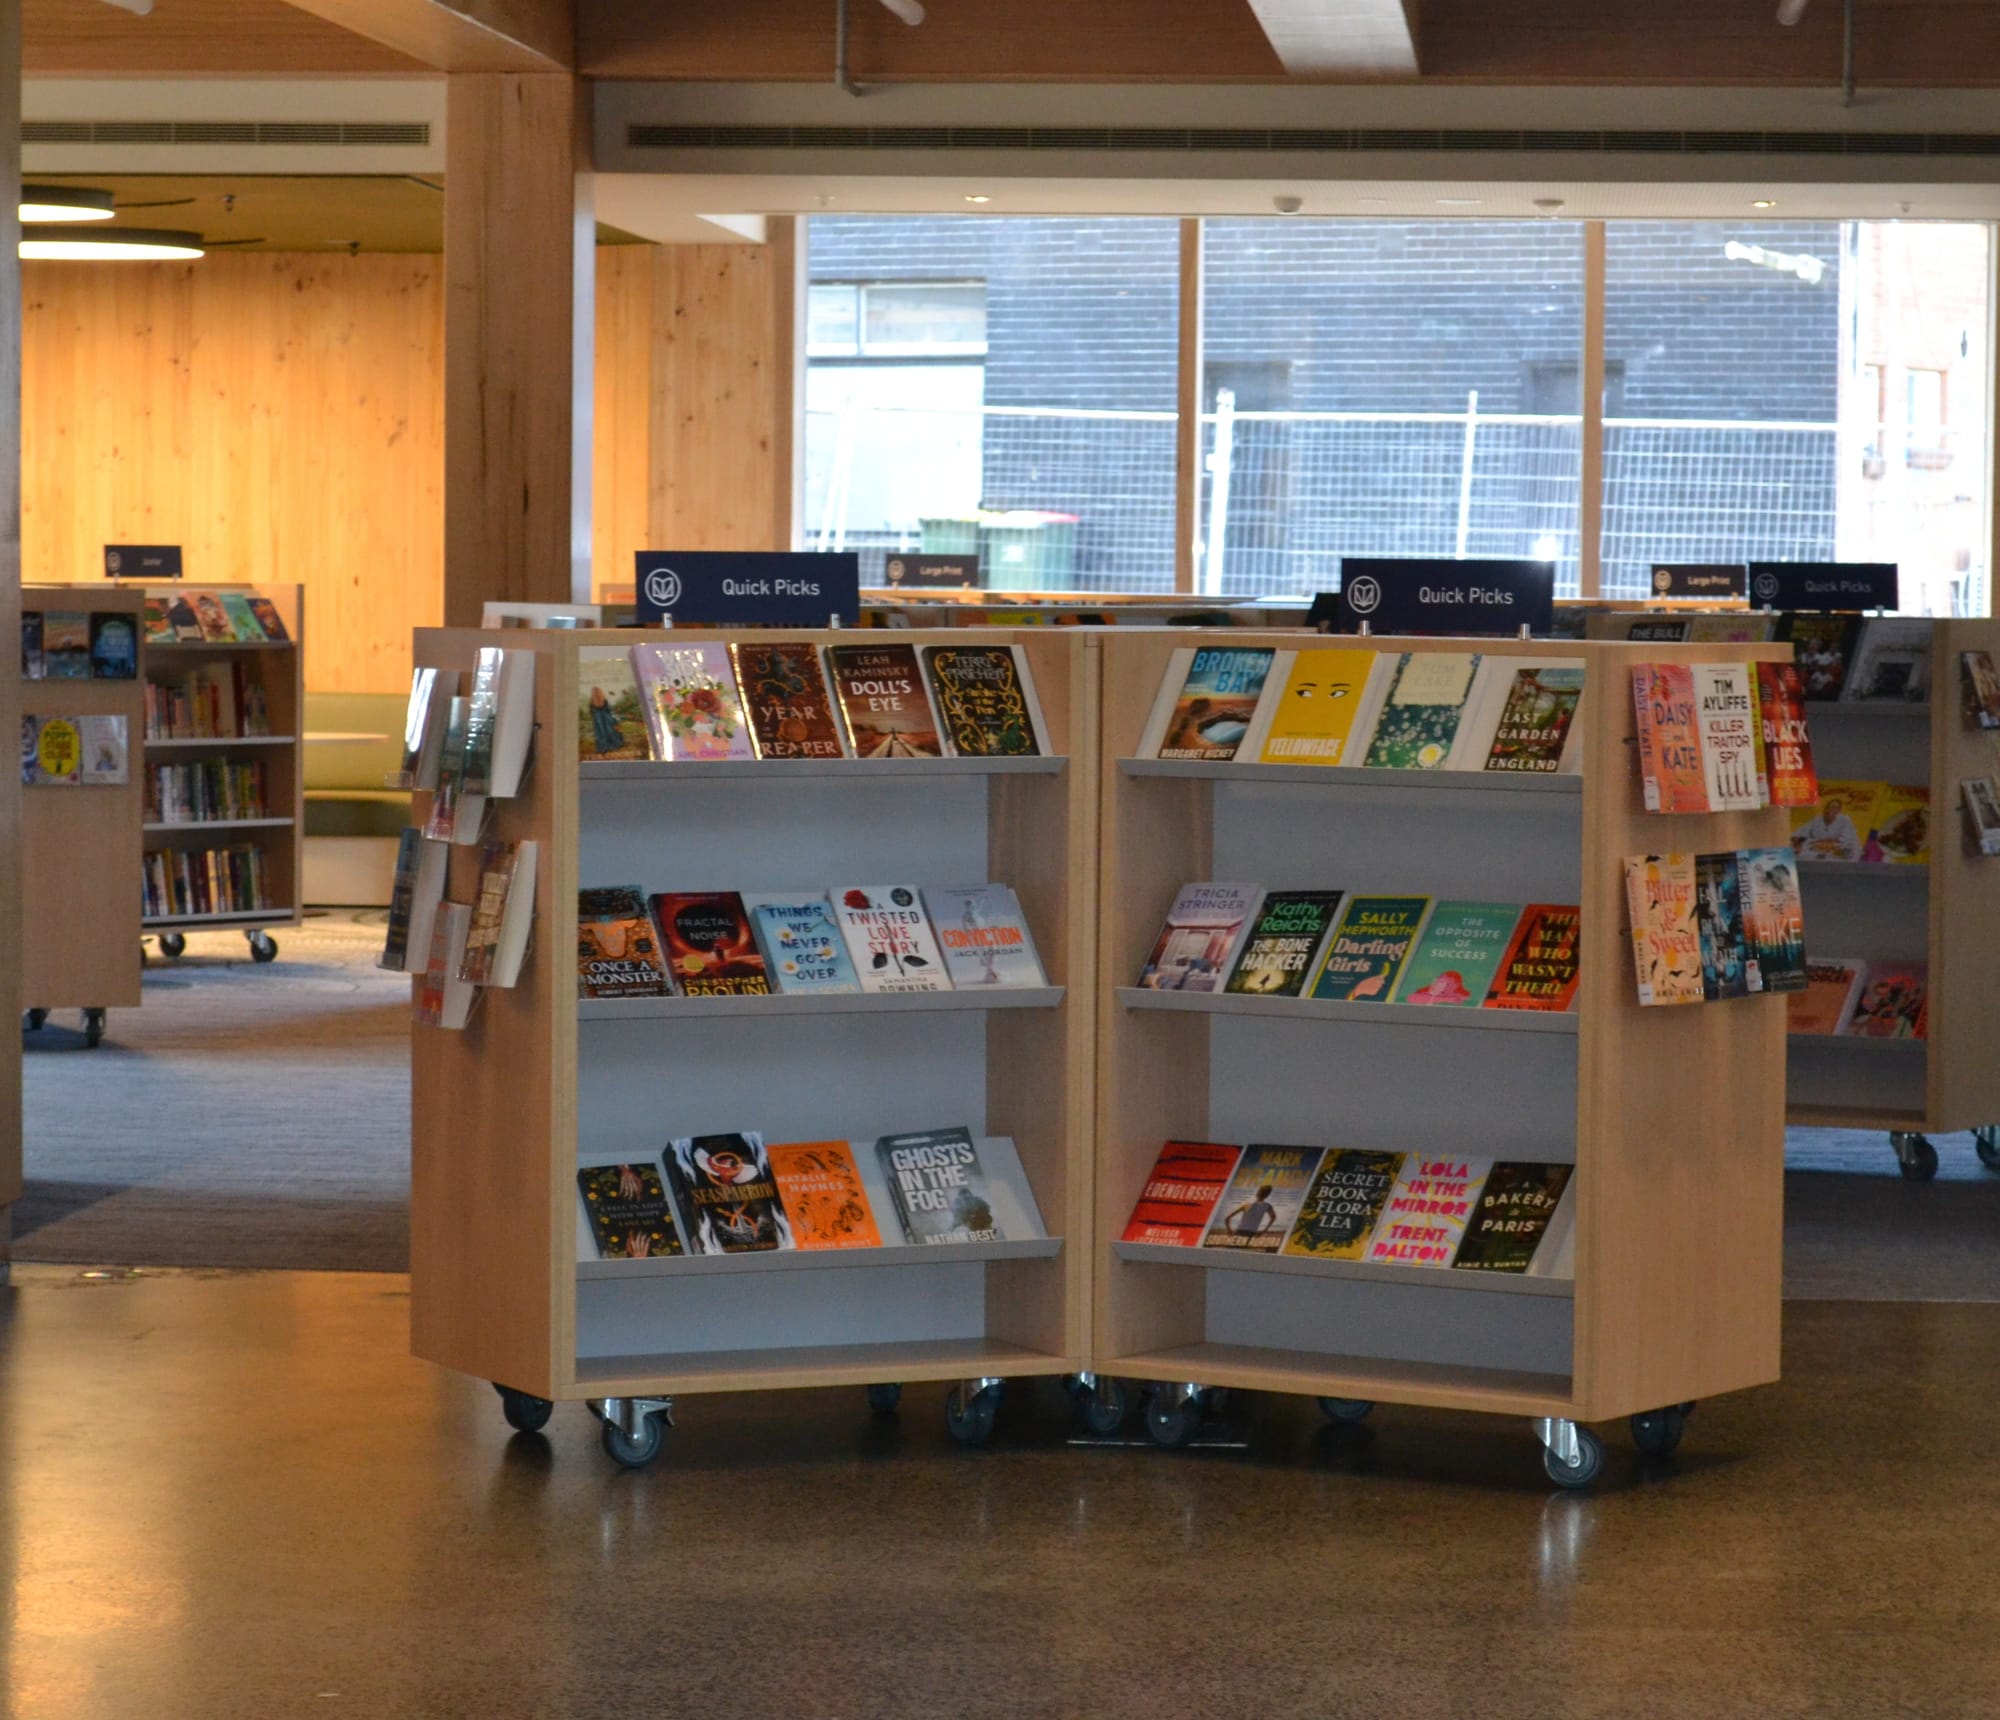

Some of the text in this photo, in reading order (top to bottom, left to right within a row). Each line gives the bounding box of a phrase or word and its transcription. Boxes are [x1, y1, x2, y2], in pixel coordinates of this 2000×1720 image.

[722, 578, 821, 596] Quick Picks
[1805, 580, 1872, 593] Quick Picks
[1418, 586, 1514, 604] Quick Picks
[857, 655, 891, 665] LEAH
[1193, 651, 1273, 673] BROKEN
[850, 680, 912, 696] DOLL'S
[1215, 671, 1260, 693] BAY
[1713, 680, 1734, 694] TIM
[868, 697, 903, 712] EYE
[1703, 696, 1749, 711] AYLIFFE
[760, 706, 817, 722] YEAR
[1502, 713, 1540, 723] LAST
[1653, 702, 1693, 726] DAISY
[1710, 719, 1745, 733] KILLER
[1762, 719, 1809, 743] BLACK
[1497, 729, 1560, 739] GARDEN
[1707, 734, 1751, 748] TRAITOR
[759, 741, 837, 756] REAPER
[1662, 746, 1697, 770] KATE
[1719, 751, 1739, 764] SPY
[1773, 747, 1804, 770] LIES
[1488, 760, 1557, 771] ENGLAND
[1193, 888, 1239, 899] TRICIA
[1178, 899, 1245, 910] STRINGER
[1272, 901, 1324, 917] Kathy
[767, 907, 823, 919] THINGS
[847, 912, 920, 925] TWISTED
[1359, 912, 1409, 924] SALLY
[676, 918, 734, 927] FRACTAL
[788, 922, 812, 933] WE
[1259, 917, 1321, 932] Reichs
[1461, 918, 1485, 927] THE
[689, 931, 729, 941] NOISE
[868, 927, 911, 940] LOVE
[942, 927, 1023, 948] CONVICTION
[1338, 925, 1416, 936] HEPWORTH
[1435, 928, 1503, 939] OPPOSITE
[1538, 930, 1578, 942] MAN
[1758, 917, 1803, 946] HIKE
[780, 938, 830, 950] NEVER
[868, 942, 920, 954] STORY
[1276, 938, 1313, 952] BONE
[1333, 938, 1408, 961] Darling
[1455, 938, 1471, 948] OF
[1648, 936, 1697, 955] Sweet
[1430, 950, 1489, 960] SUCCESS
[1527, 947, 1573, 960] WHO
[589, 960, 652, 973] ONCE A
[1240, 953, 1308, 971] HACKER
[1327, 957, 1372, 973] Girls
[586, 971, 663, 985] MONSTER
[796, 968, 837, 980] OVER
[683, 976, 765, 987] CHRISTOPHER
[1505, 981, 1566, 995] THERE
[686, 984, 769, 997] PAOLINI
[891, 1142, 975, 1171] GHOSTS
[1259, 1151, 1304, 1166] MARK
[1419, 1161, 1469, 1178] LOLA
[777, 1173, 828, 1183] NATALIE
[897, 1165, 969, 1191] IN THE
[1321, 1171, 1388, 1187] SECRET
[690, 1183, 775, 1205] SEASPARROW
[790, 1182, 845, 1193] HAYNES
[1318, 1186, 1369, 1200] BOOK
[1408, 1180, 1468, 1197] IN THE
[905, 1189, 949, 1212] FOG
[1391, 1197, 1469, 1215] MIRROR
[1484, 1193, 1557, 1209] BAKERY
[1315, 1201, 1372, 1216] FLORA
[1319, 1216, 1352, 1229] LEA
[1481, 1220, 1537, 1232] PARIS
[1390, 1225, 1448, 1241] TRENT
[1372, 1243, 1448, 1261] DALTON
